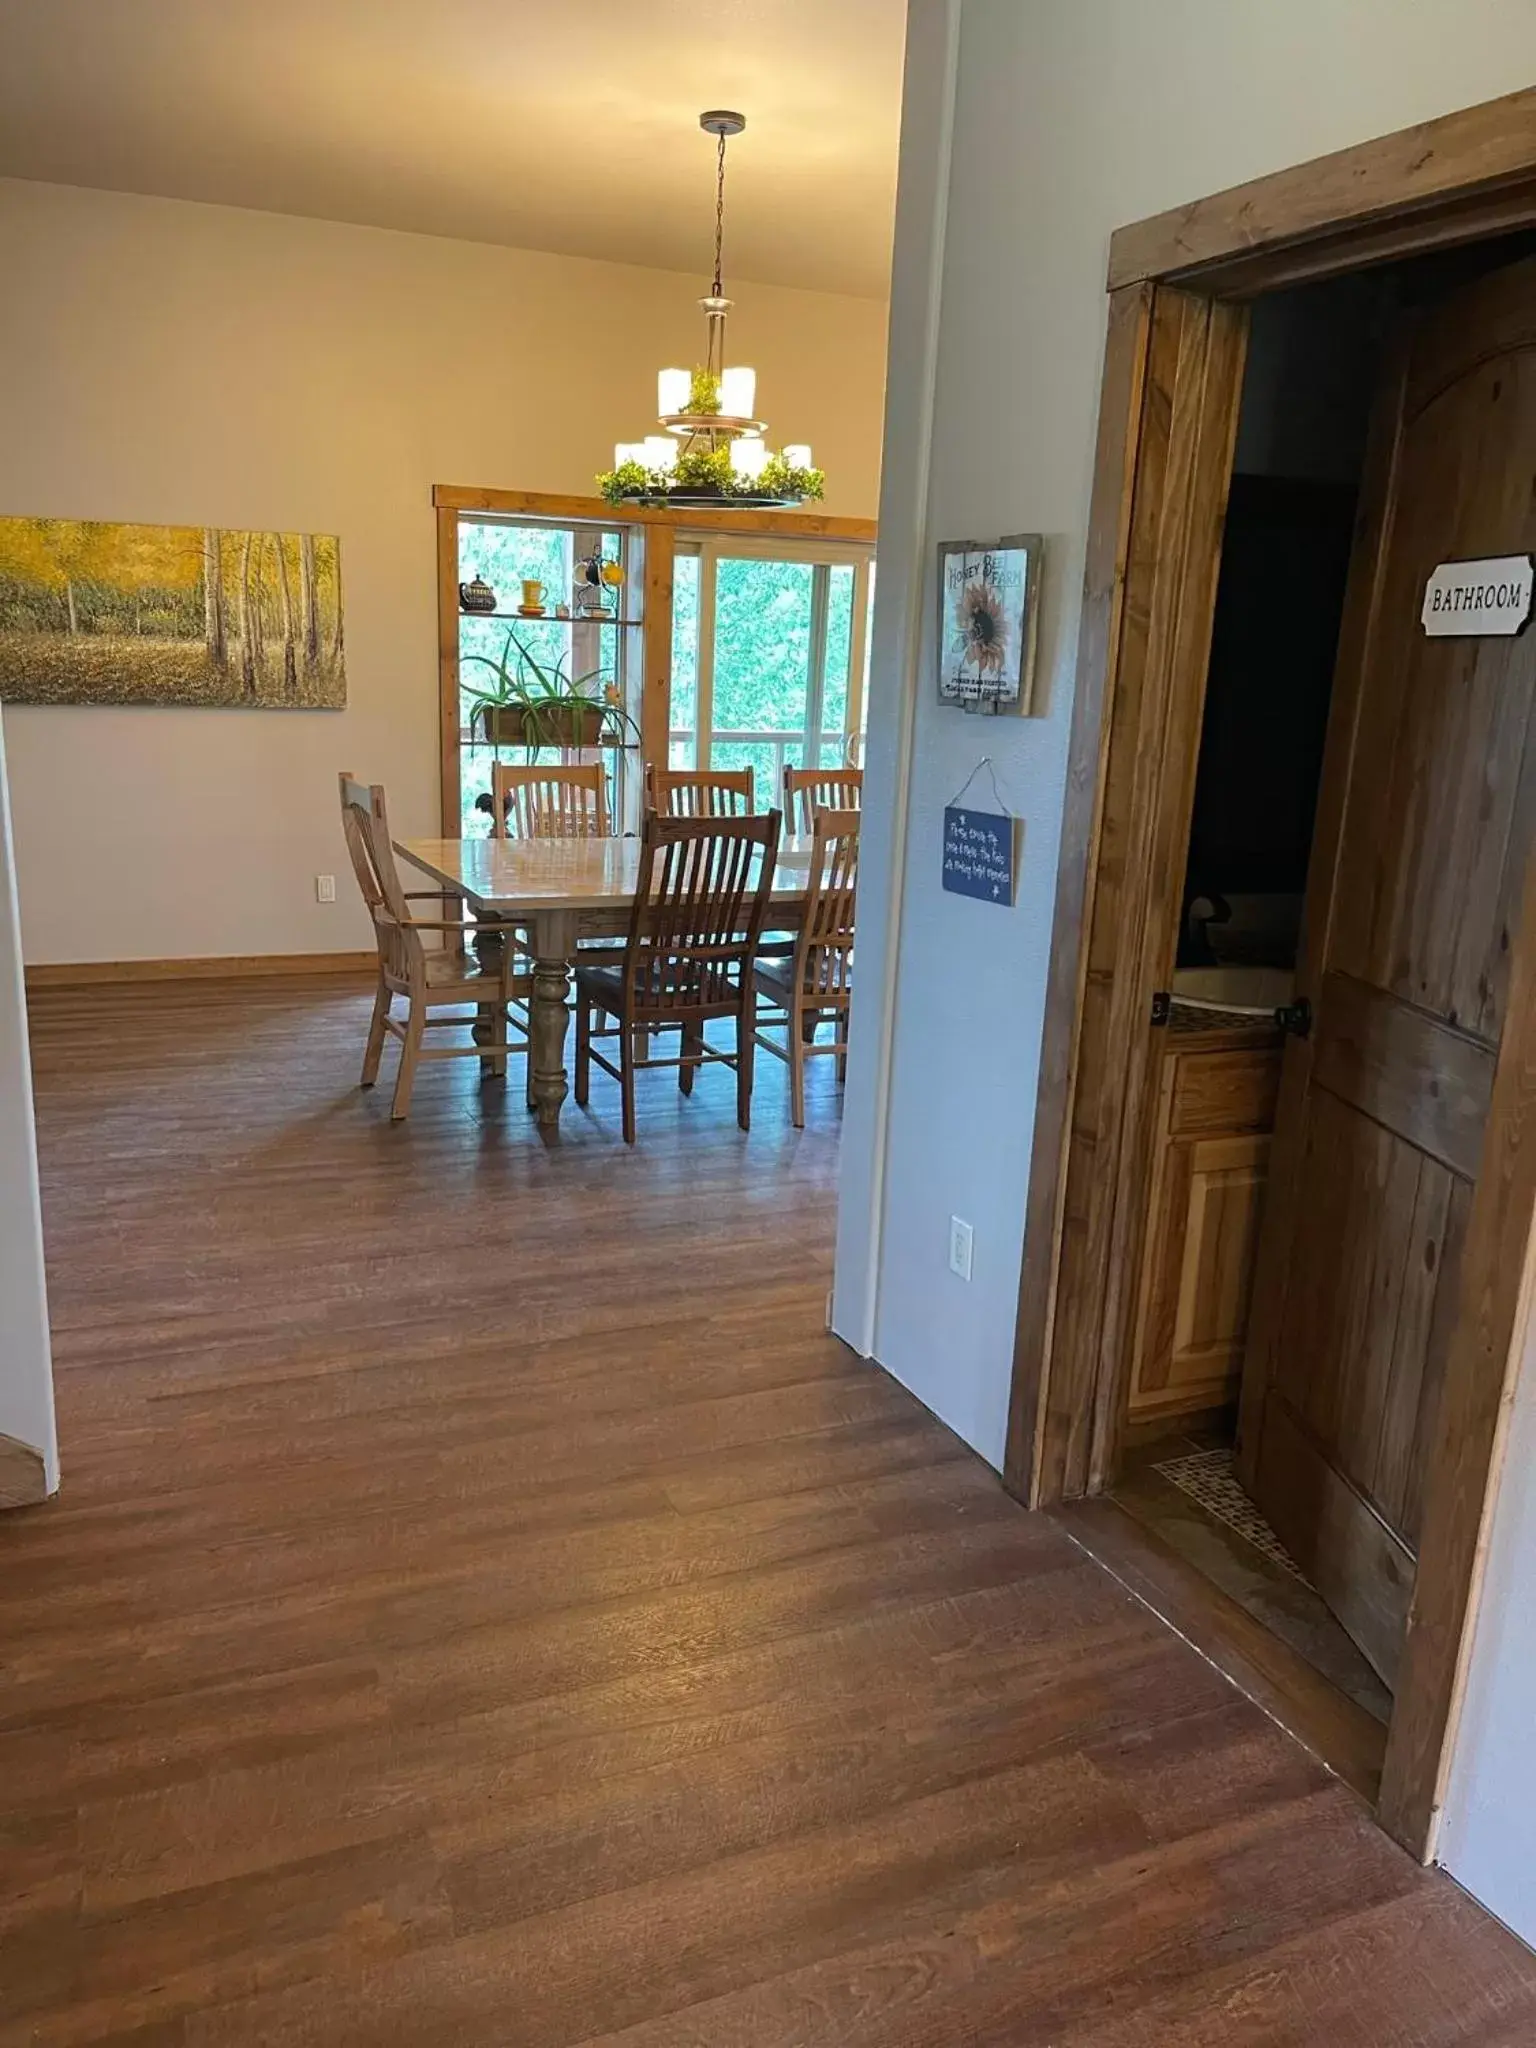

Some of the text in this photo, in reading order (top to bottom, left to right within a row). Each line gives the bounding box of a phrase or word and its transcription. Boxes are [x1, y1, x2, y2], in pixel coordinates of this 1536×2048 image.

[949, 554, 1005, 589] HONEY BEE
[1432, 583, 1522, 612] BATHROOM
